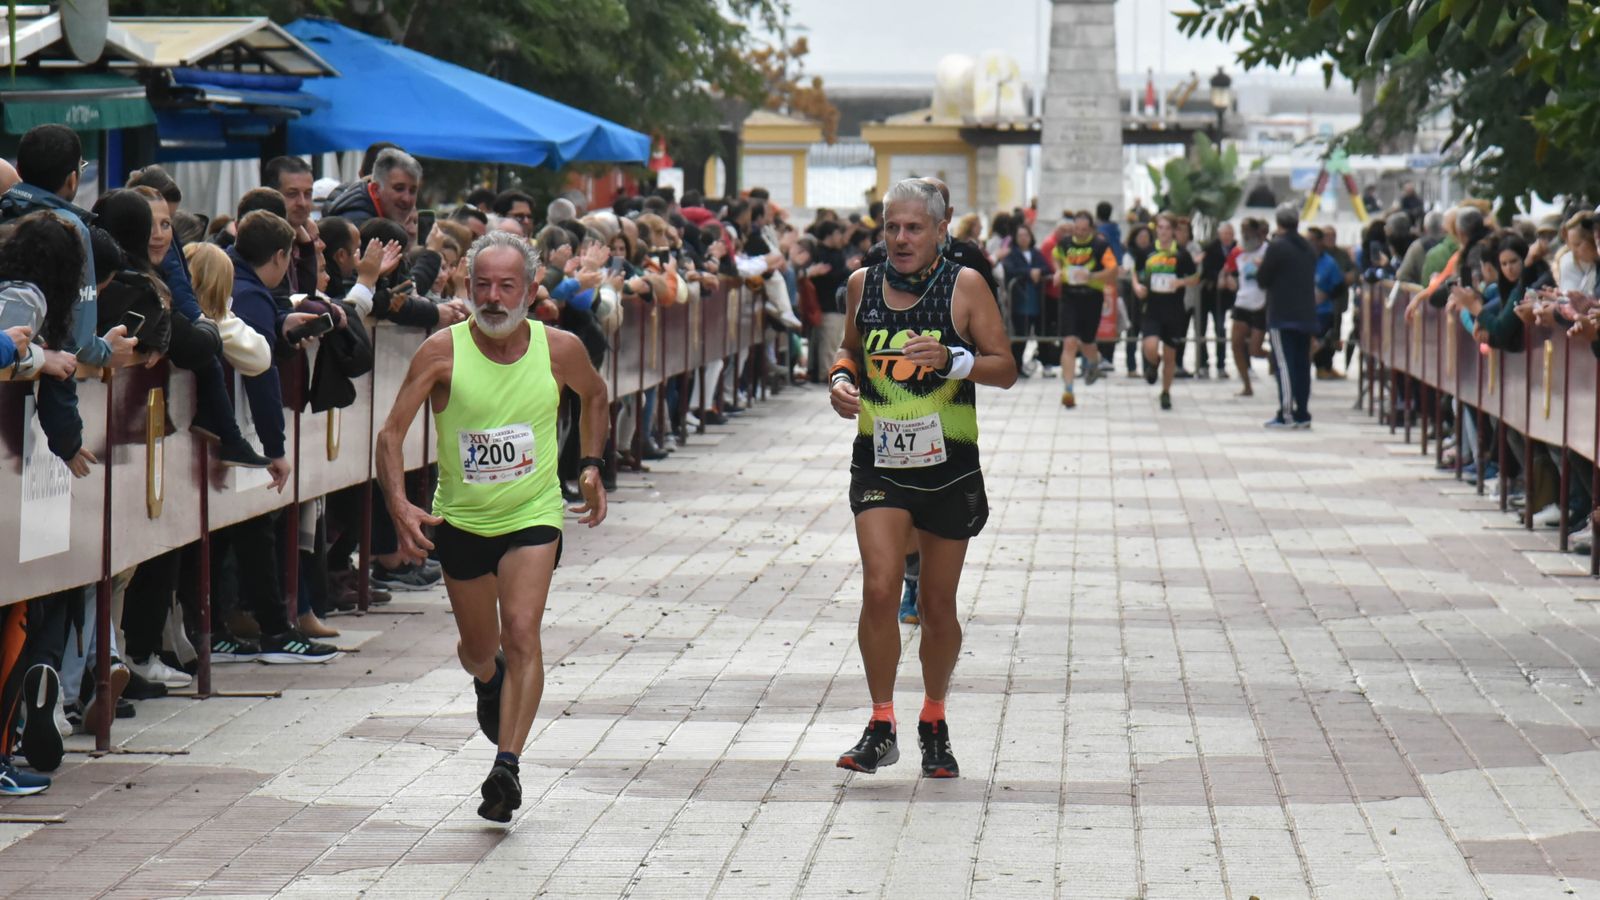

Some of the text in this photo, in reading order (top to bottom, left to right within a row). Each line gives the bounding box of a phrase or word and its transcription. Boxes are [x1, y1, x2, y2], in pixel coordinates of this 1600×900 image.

[883, 422, 900, 432] XIV
[469, 433, 490, 443] XIV
[894, 433, 916, 451] 47
[477, 441, 515, 465] 200
